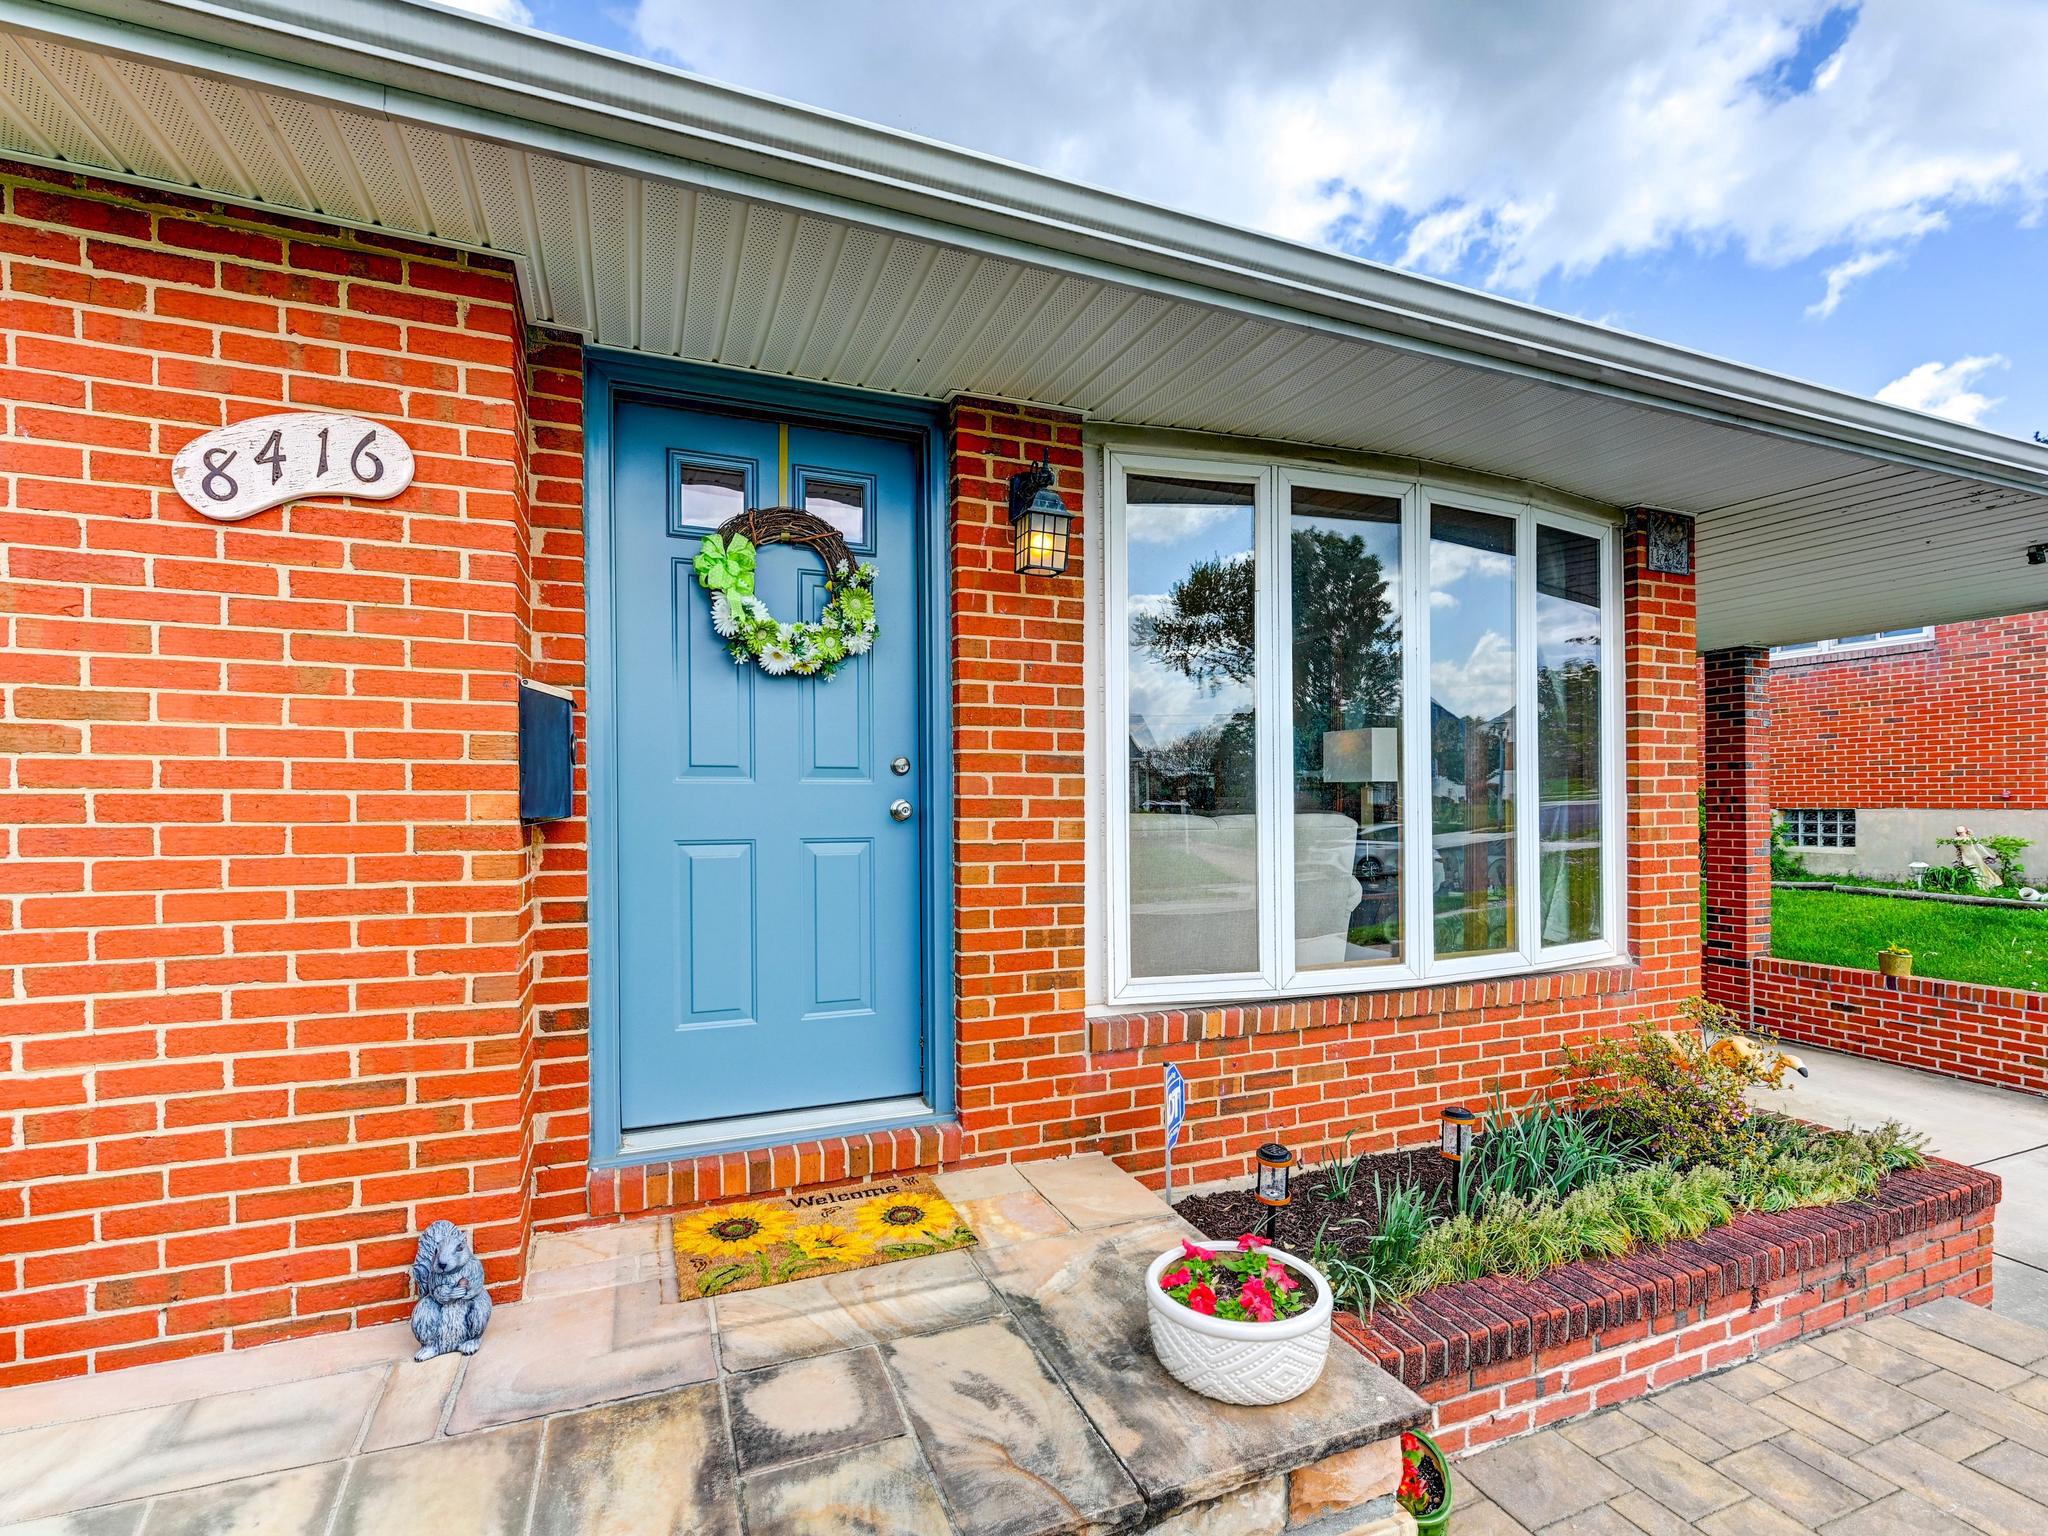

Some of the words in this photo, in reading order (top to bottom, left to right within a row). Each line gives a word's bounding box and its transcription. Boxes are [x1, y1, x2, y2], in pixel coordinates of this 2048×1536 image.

[201, 427, 384, 502] 8416
[1167, 1085, 1180, 1126] DT
[787, 1183, 900, 1209] Welcome
